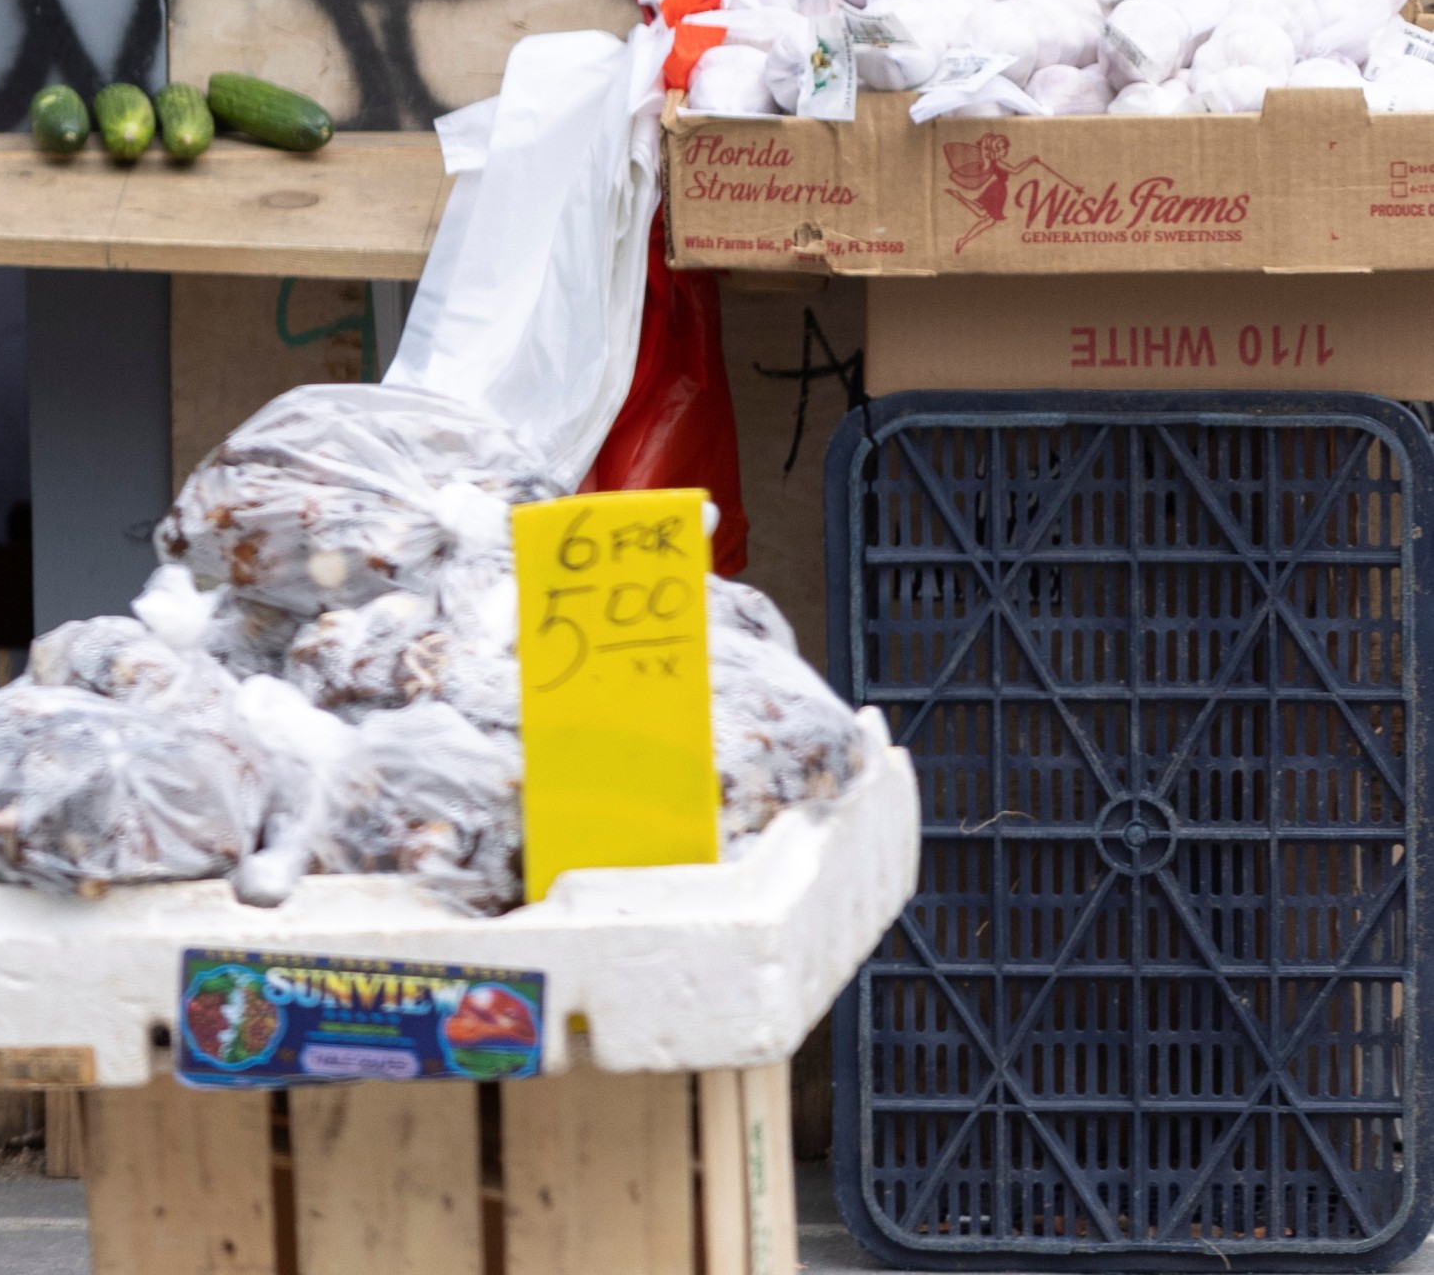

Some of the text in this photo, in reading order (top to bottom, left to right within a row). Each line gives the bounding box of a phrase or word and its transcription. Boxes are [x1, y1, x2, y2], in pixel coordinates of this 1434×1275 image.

[685, 134, 792, 167] Florida
[684, 170, 860, 206] Strawberries
[1014, 176, 1251, 230] Wish Farms
[1370, 203, 1426, 217] PRODUCE
[684, 235, 714, 250] Wish
[716, 236, 754, 251] Farms
[1021, 229, 1243, 244] GENERATIONS OF SWEETNESS
[1070, 323, 1335, 368] 1/10 WHITE
[558, 507, 688, 573] 6 FOR
[262, 965, 468, 1017] SUNVIEW
